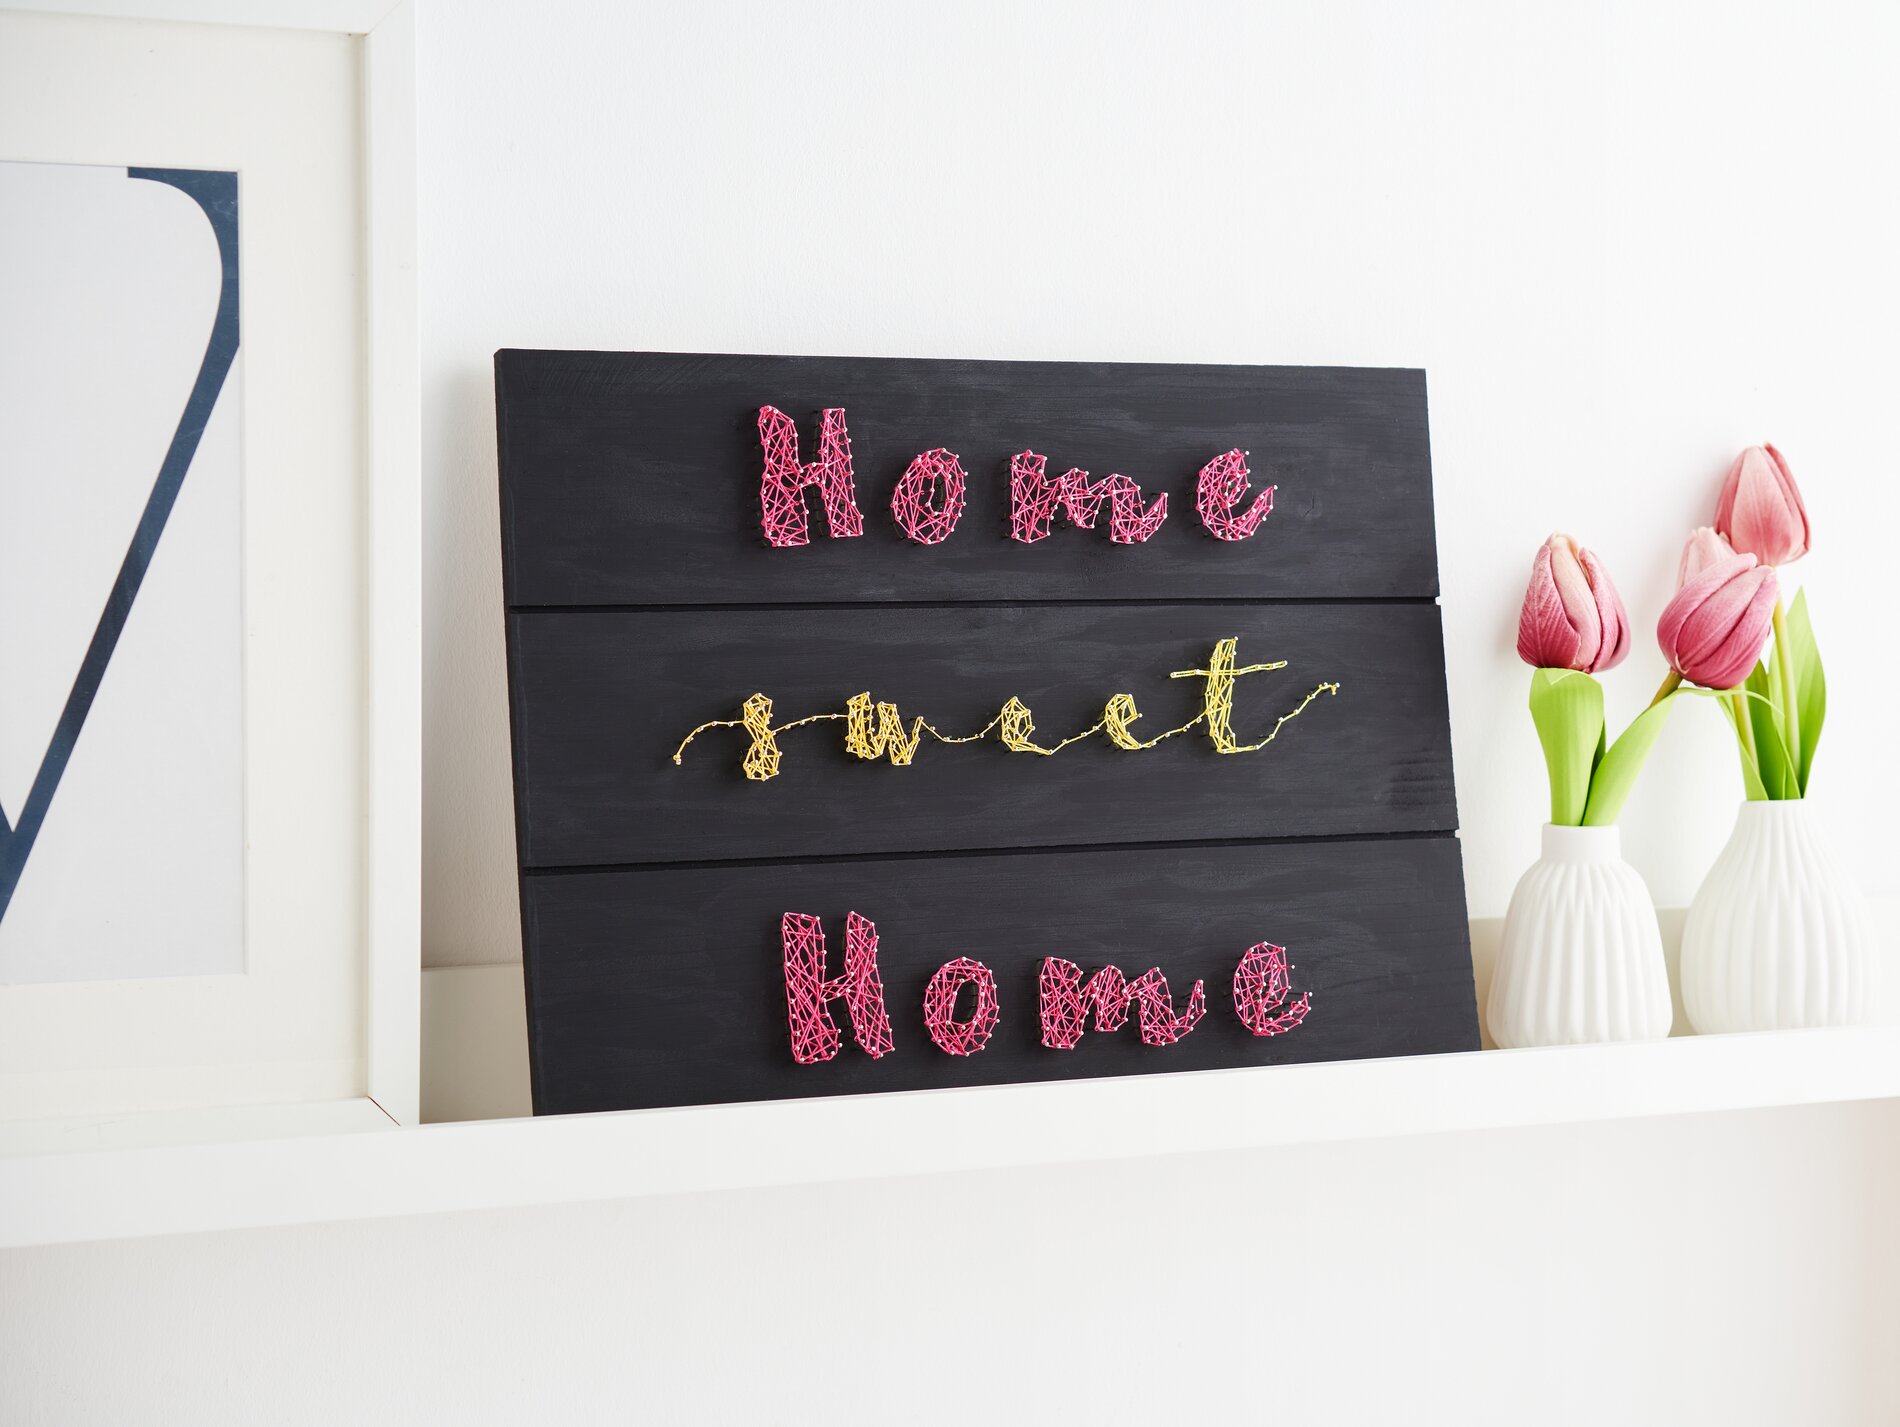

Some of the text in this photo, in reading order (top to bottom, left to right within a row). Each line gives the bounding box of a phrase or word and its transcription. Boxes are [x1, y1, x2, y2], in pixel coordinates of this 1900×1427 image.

[757, 405, 1277, 546] Home
[672, 638, 1340, 781] sweet
[781, 911, 1312, 1064] Home
